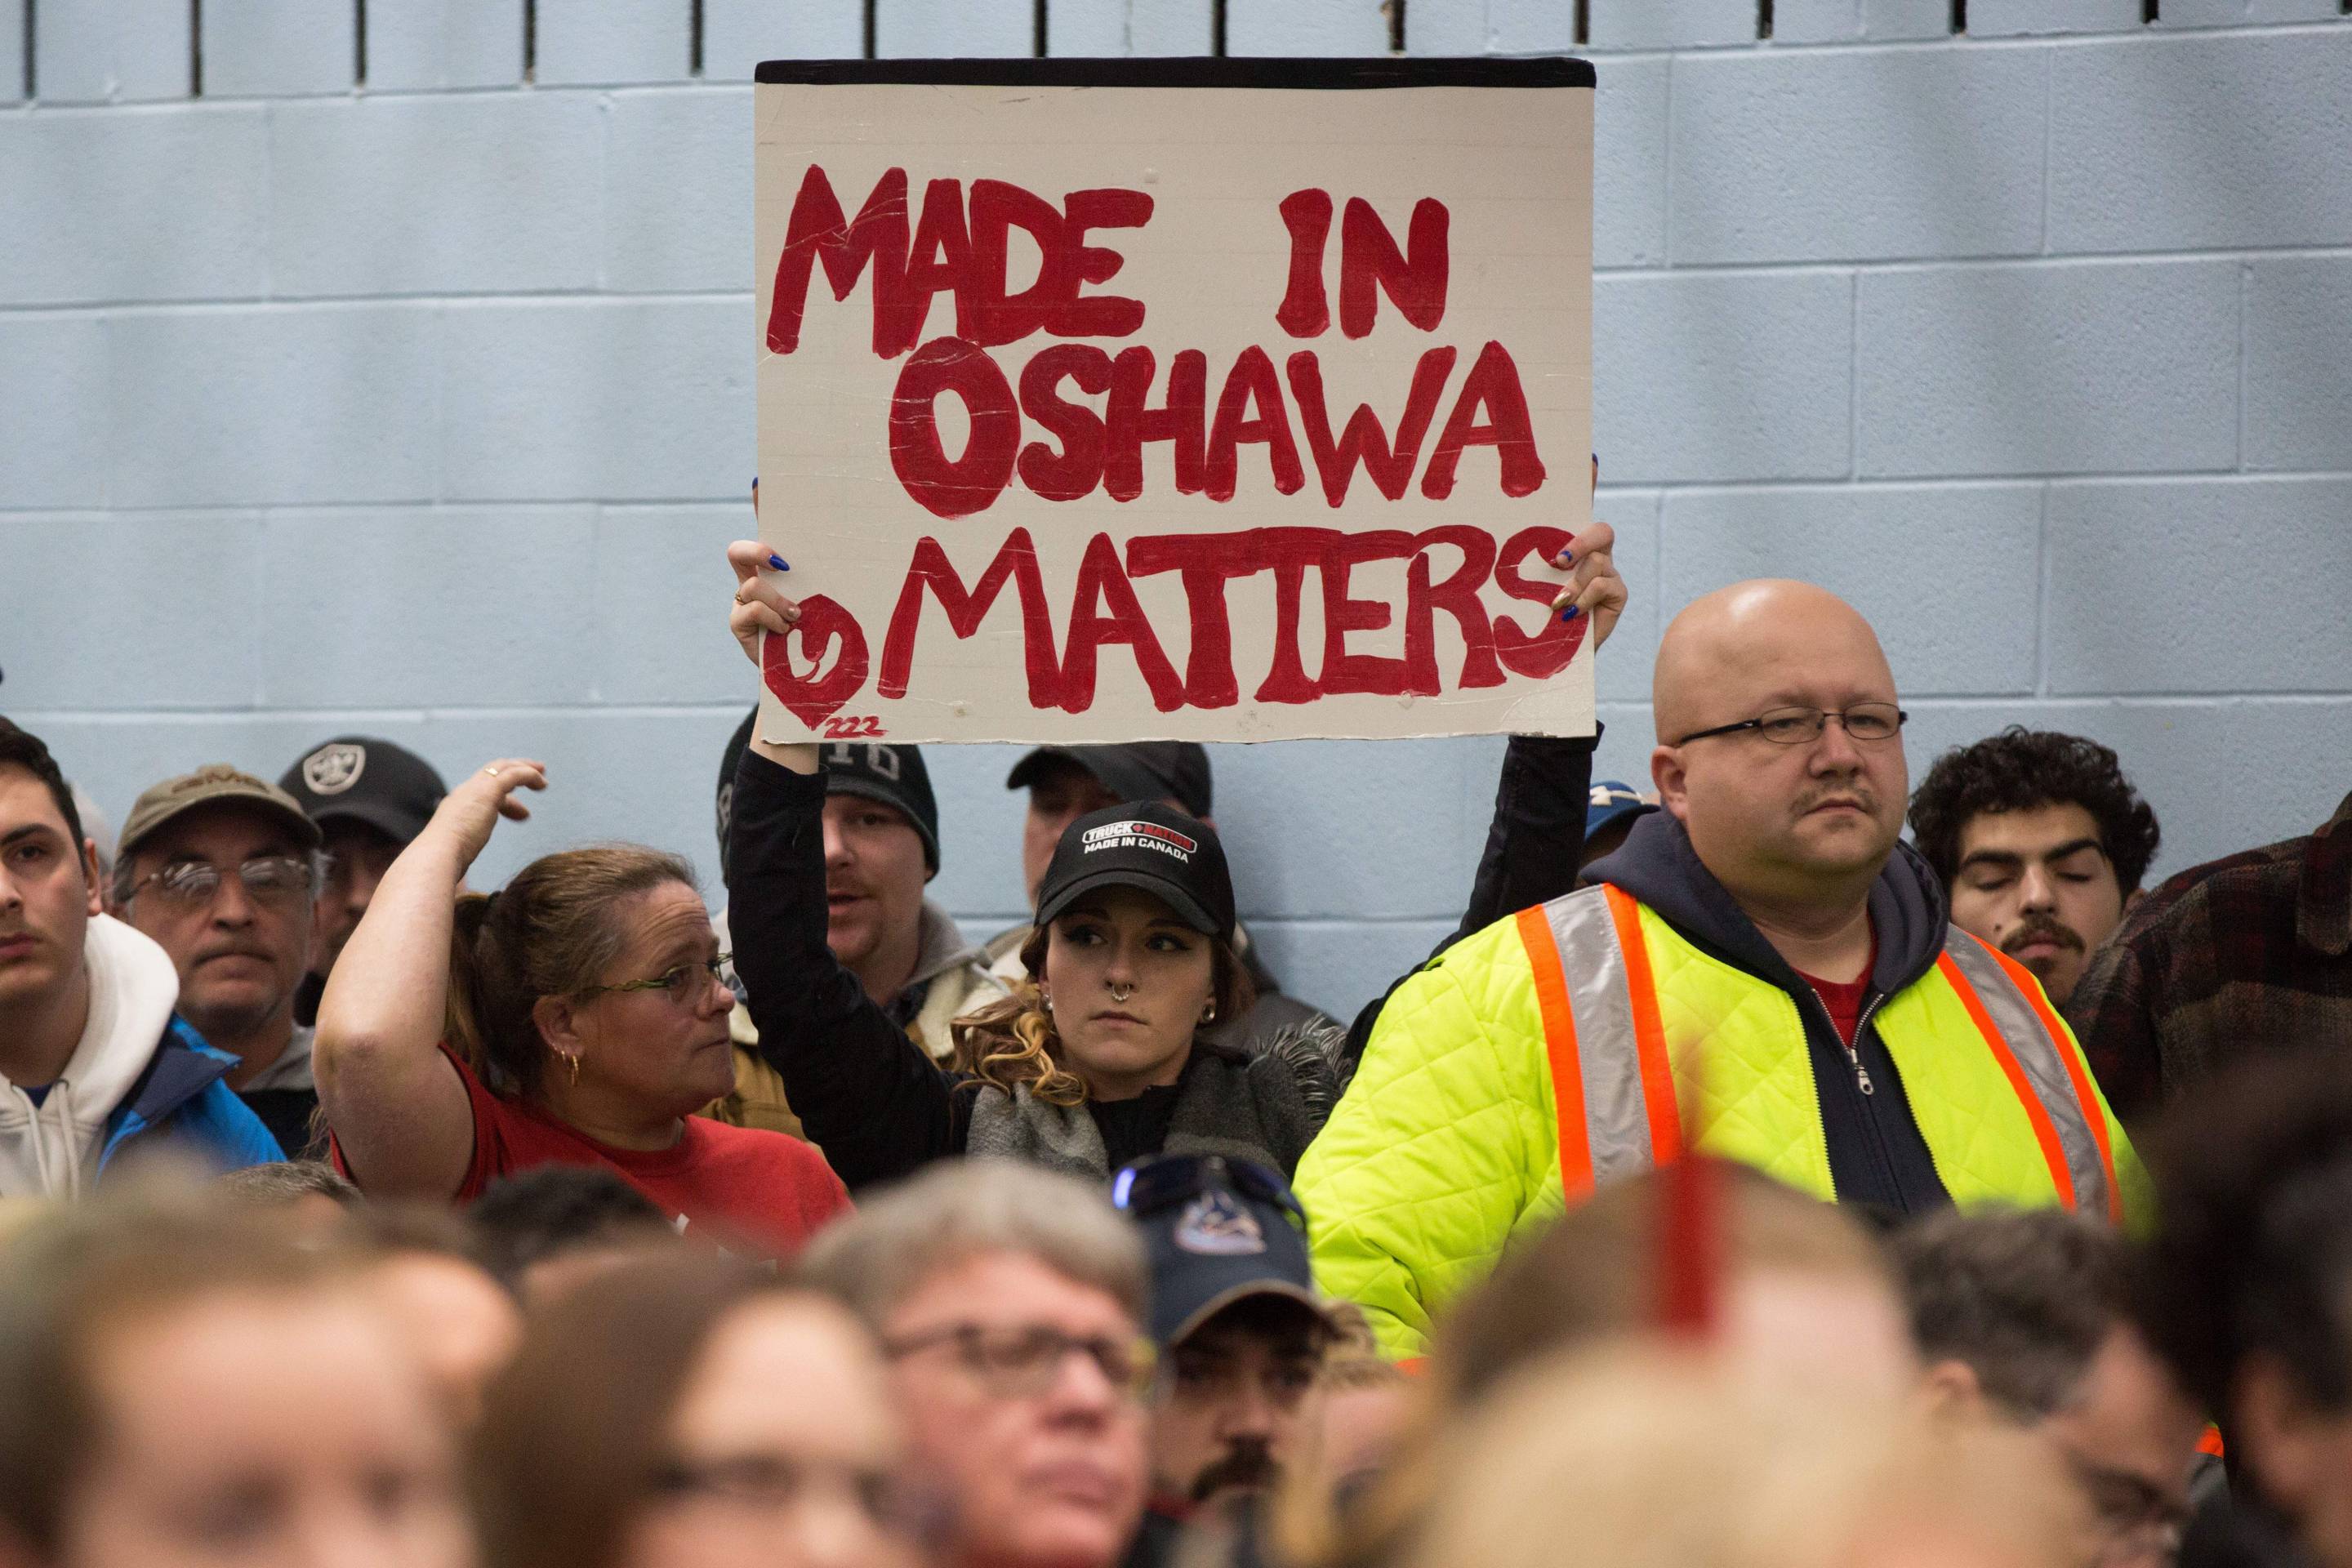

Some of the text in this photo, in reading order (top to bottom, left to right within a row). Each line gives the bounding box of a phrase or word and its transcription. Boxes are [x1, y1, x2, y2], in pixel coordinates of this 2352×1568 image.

[767, 164, 1450, 359] MADE IN
[889, 336, 1547, 519] OSHAWA
[877, 524, 1589, 715] MATTERS
[824, 715, 888, 739] 222
[1085, 837, 1188, 863] MADE IN CANADA
[1089, 822, 1192, 850] TRUCK NATION
